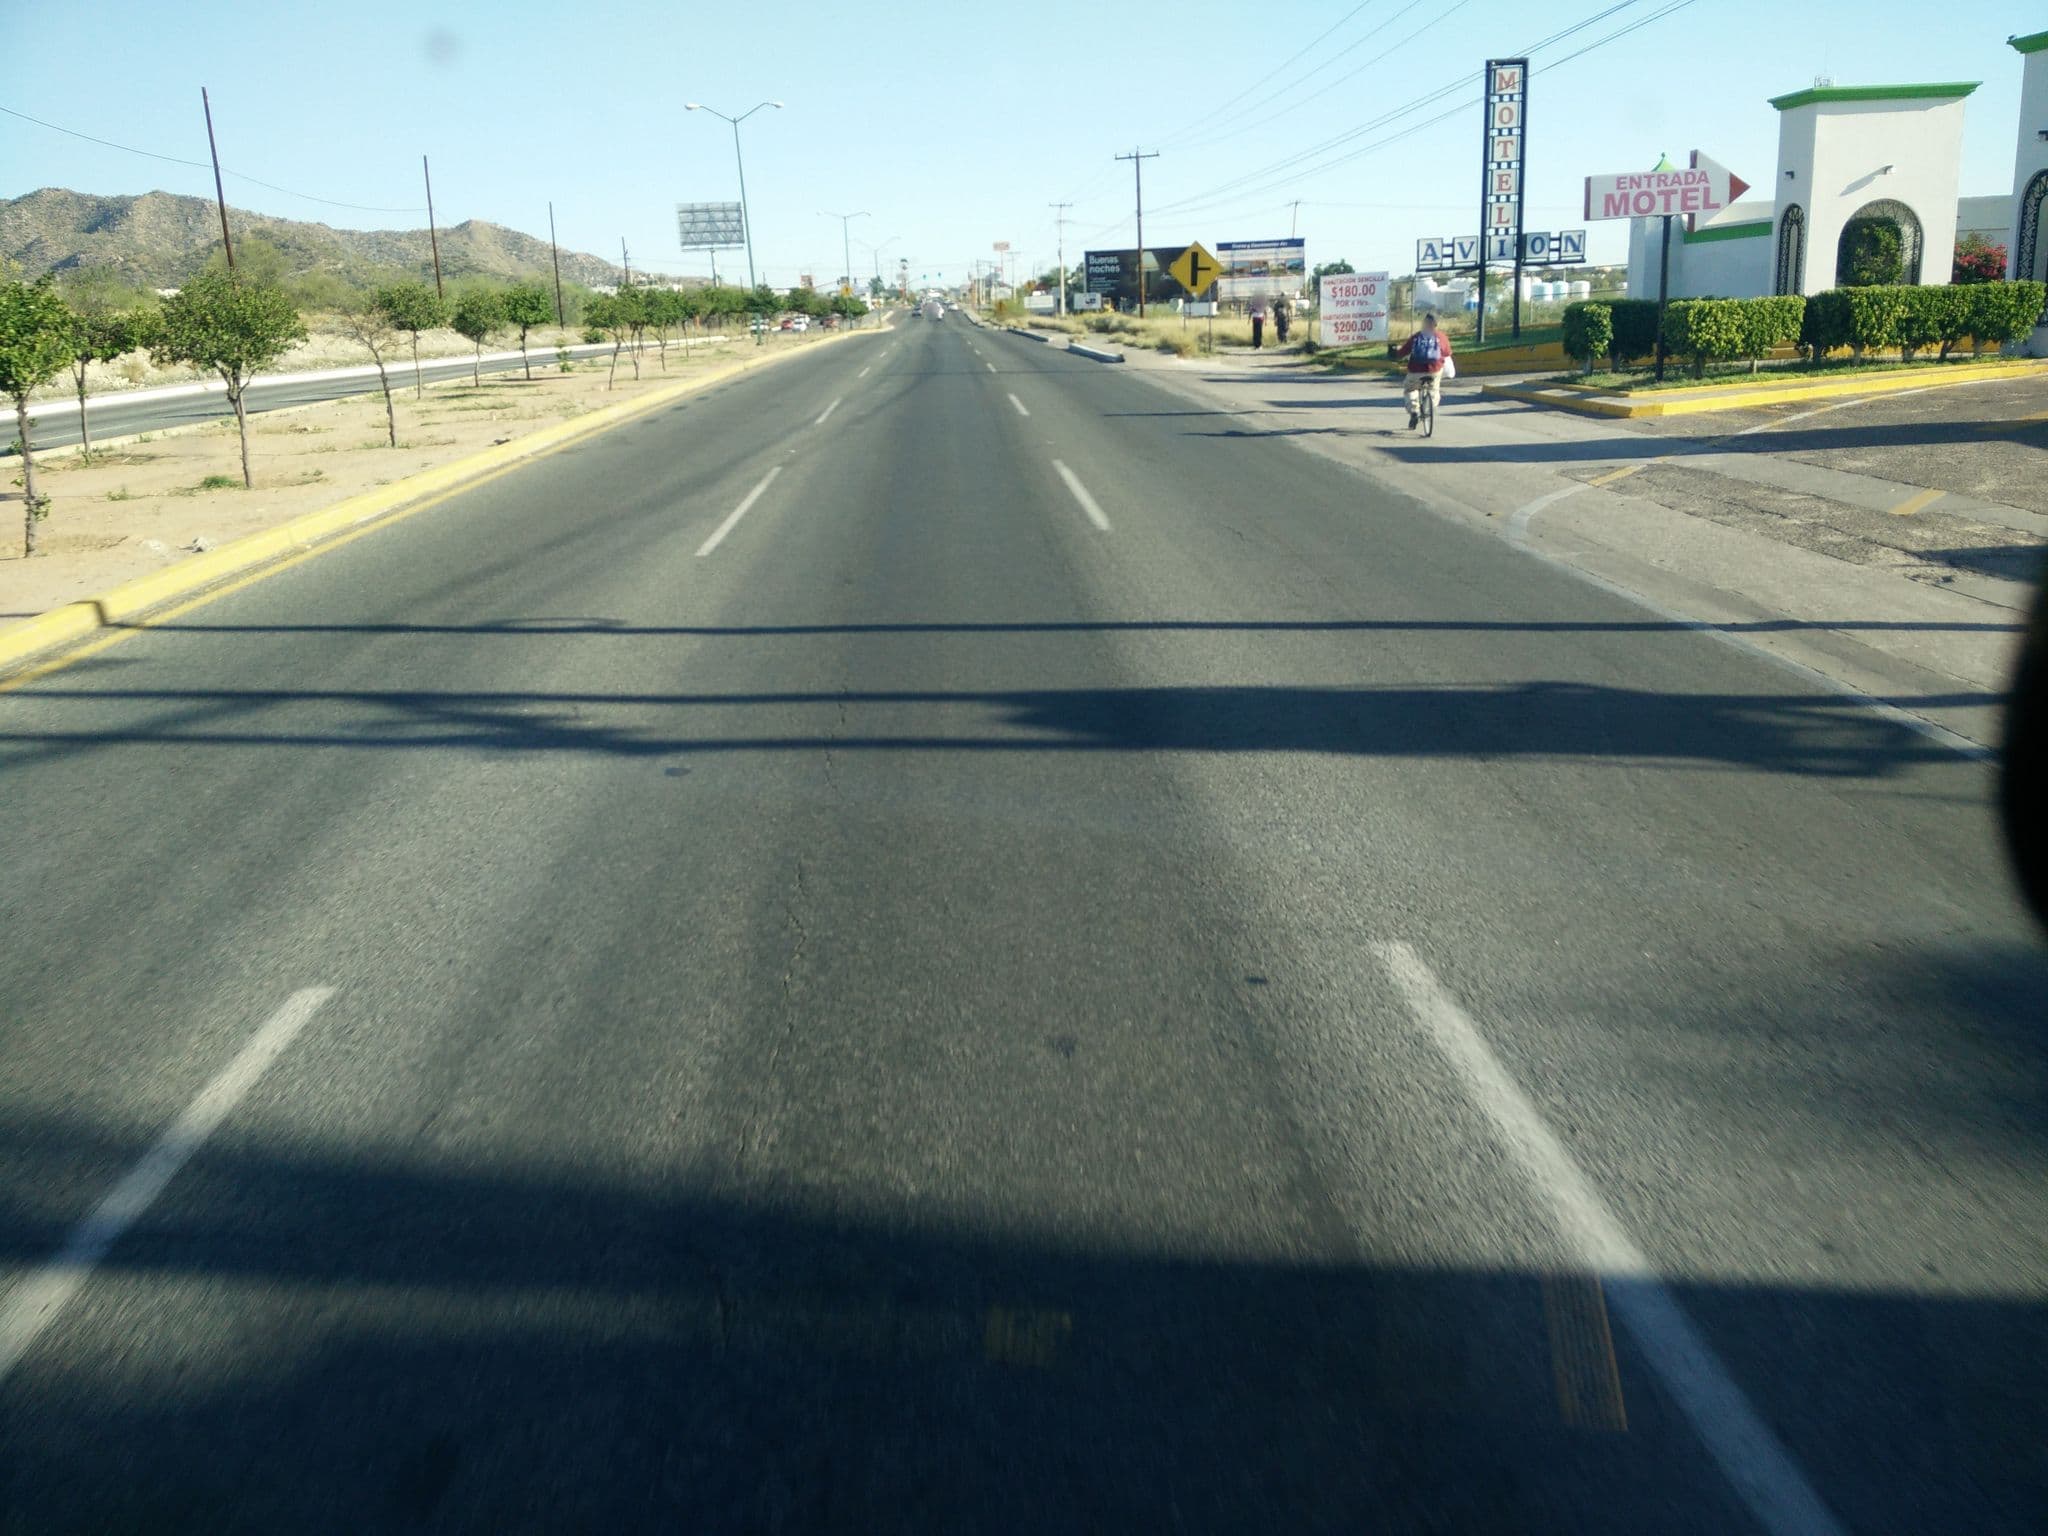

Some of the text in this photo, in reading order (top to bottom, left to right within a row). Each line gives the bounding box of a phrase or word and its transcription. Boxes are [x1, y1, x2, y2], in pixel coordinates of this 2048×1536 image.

[1496, 69, 1517, 226] MOTEL
[1615, 171, 1710, 190] ENTRADA
[1603, 187, 1721, 218] MOTEL
[1422, 233, 1583, 261] AVION
[1088, 255, 1119, 265] Buenas
[1088, 264, 1120, 274] noches
[1331, 284, 1376, 298] $180.00
[1334, 319, 1373, 334] $200.00
